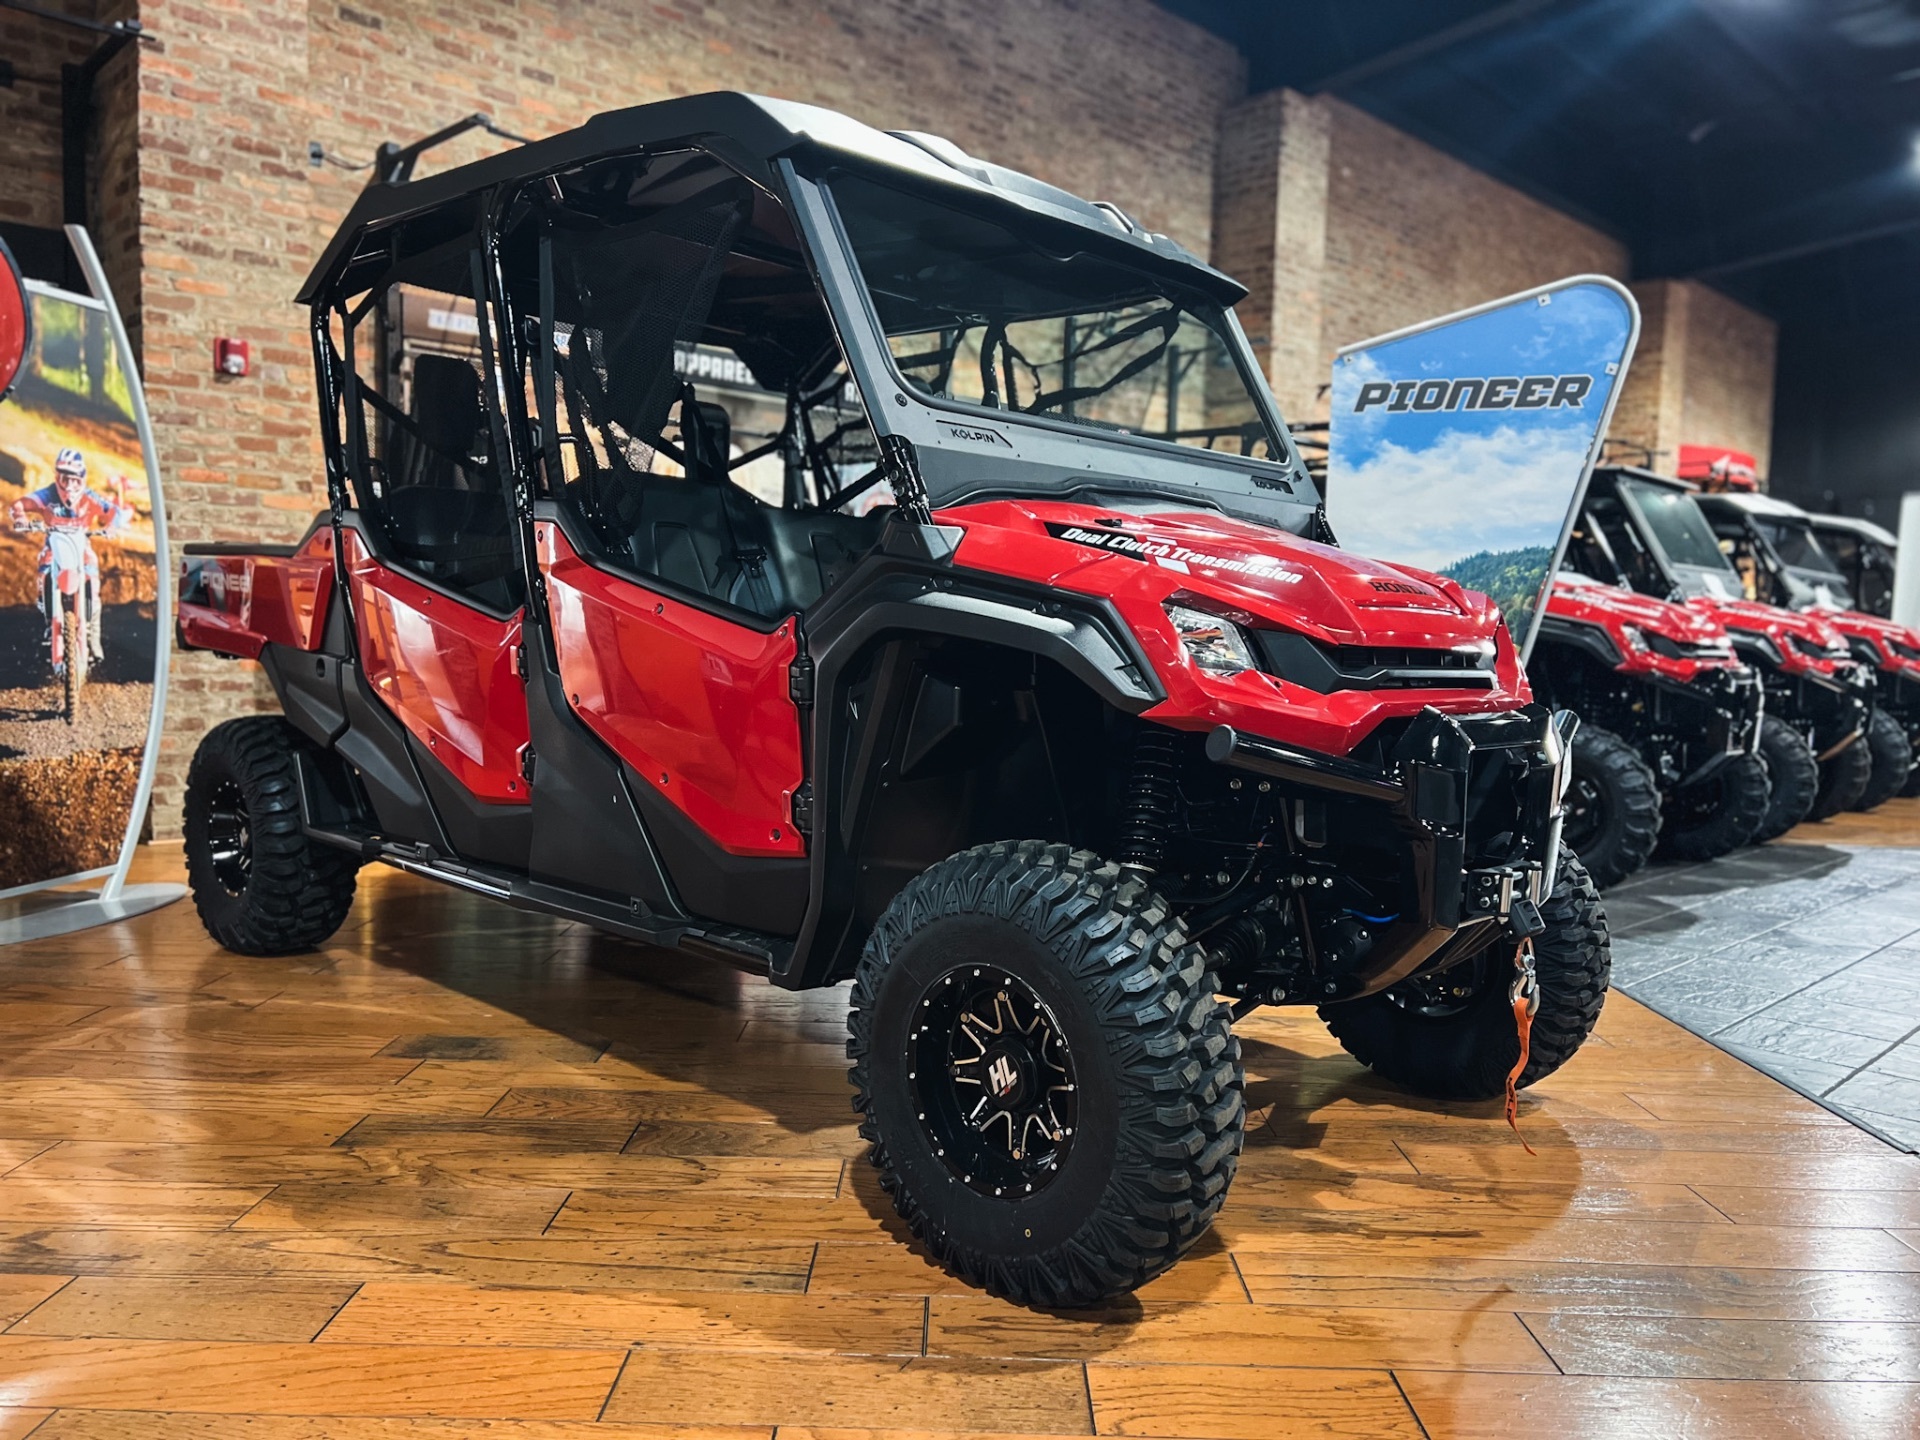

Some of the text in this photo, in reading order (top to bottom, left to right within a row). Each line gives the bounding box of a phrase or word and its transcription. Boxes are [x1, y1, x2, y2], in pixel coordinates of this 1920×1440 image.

[1352, 375, 1593, 413] PIONEER
[950, 428, 995, 444] KOLPIN
[1060, 527, 1303, 584] Dual Clutch Transmission
